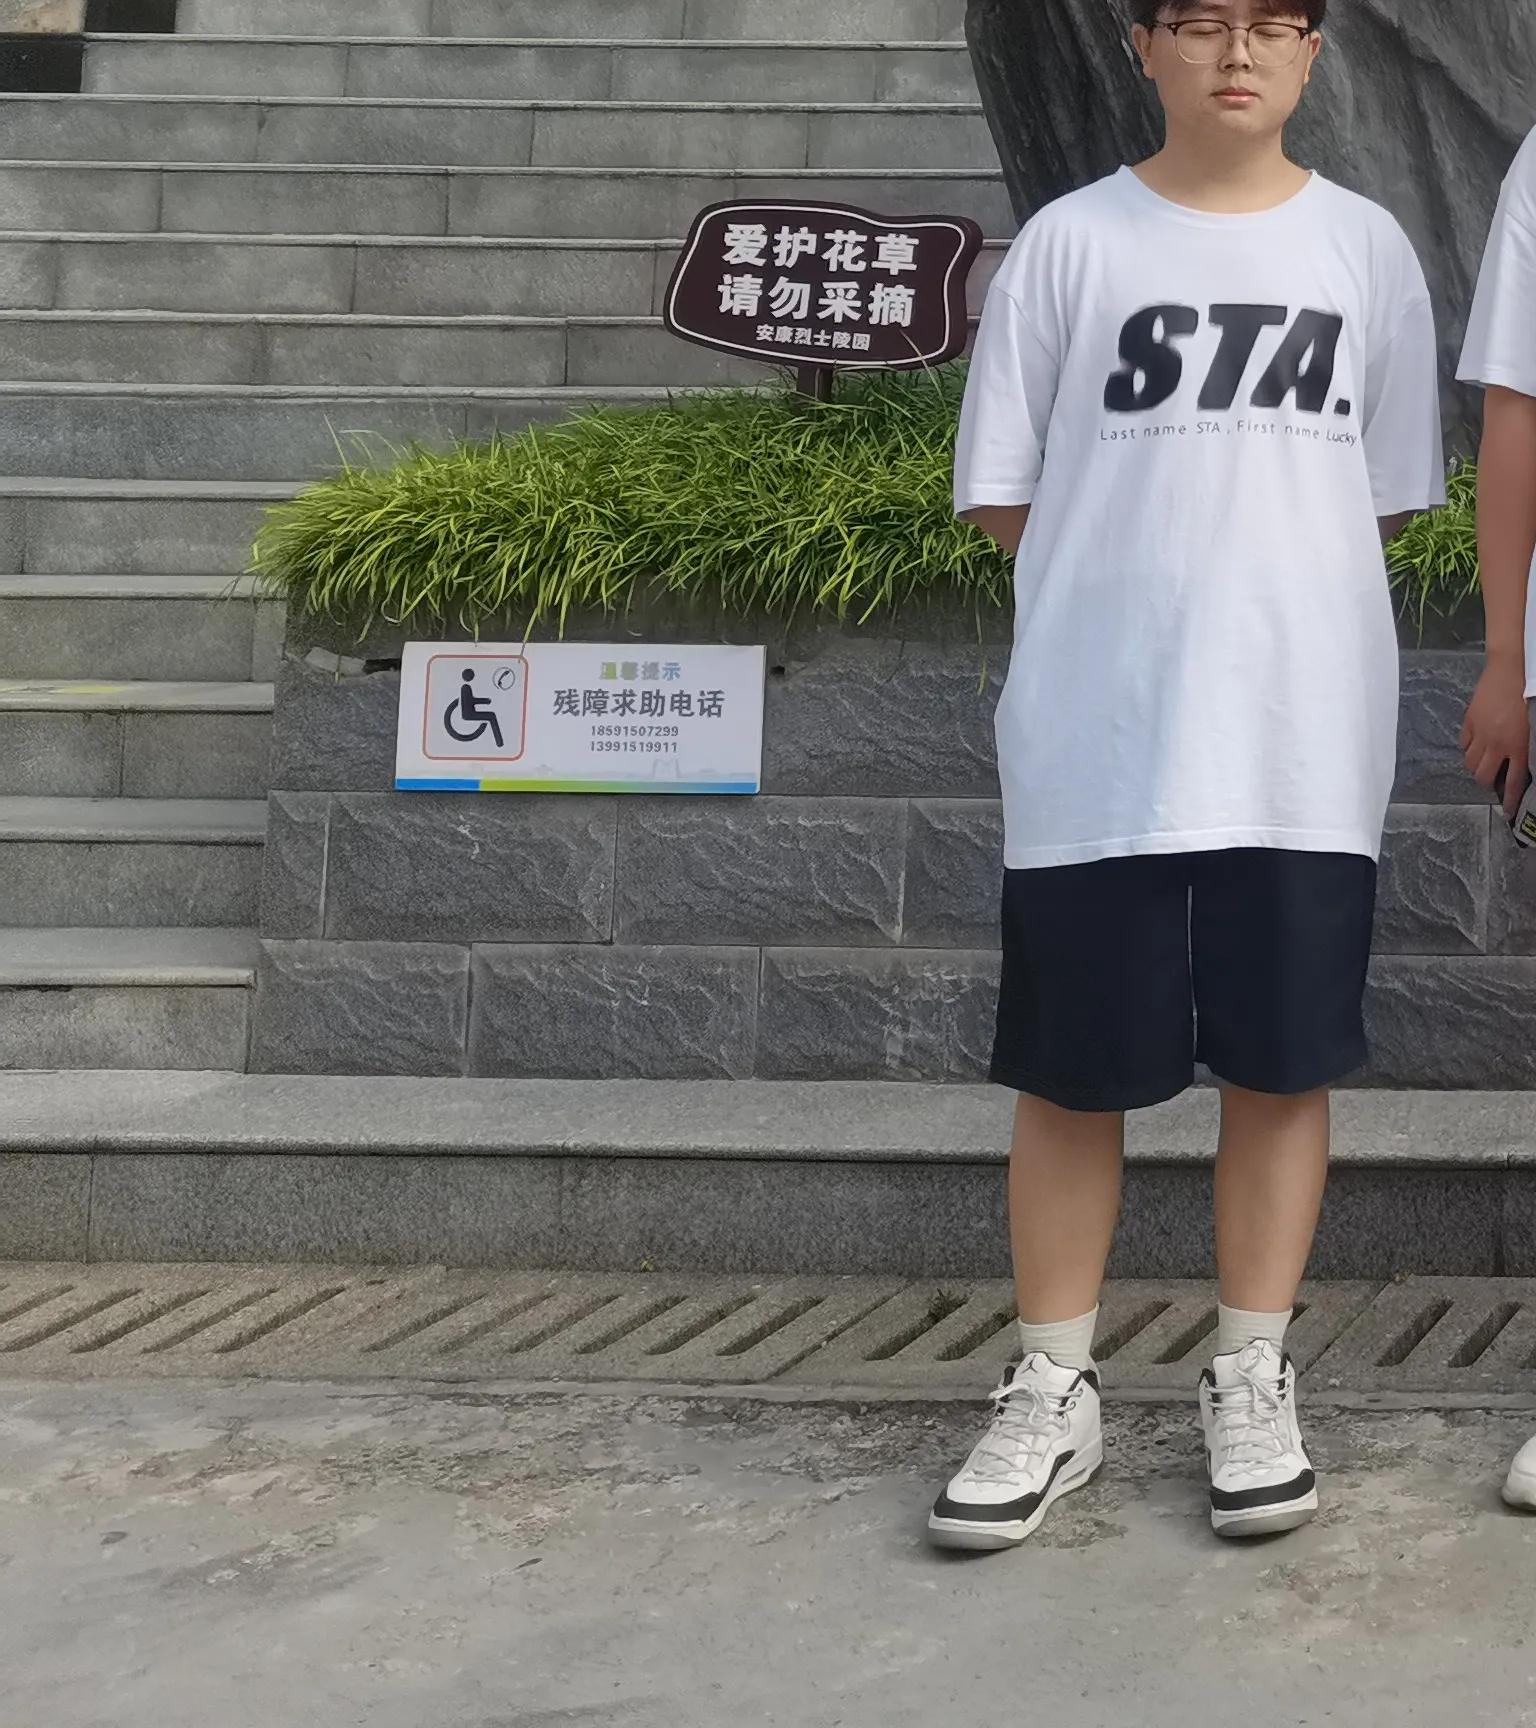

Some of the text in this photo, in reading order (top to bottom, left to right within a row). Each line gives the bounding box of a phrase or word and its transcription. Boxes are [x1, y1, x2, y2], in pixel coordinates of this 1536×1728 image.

[722, 222, 920, 276] 爱护花草
[717, 274, 916, 329] 请勿采摘
[756, 323, 871, 352] 安康烈士陵园
[1100, 428, 1136, 441] Last
[1143, 425, 1187, 437] name
[1236, 419, 1275, 435] First
[1284, 424, 1320, 438] name
[1325, 429, 1358, 447] Lucky
[599, 661, 681, 681] 温馨提示
[553, 688, 725, 718] 残障求助电话
